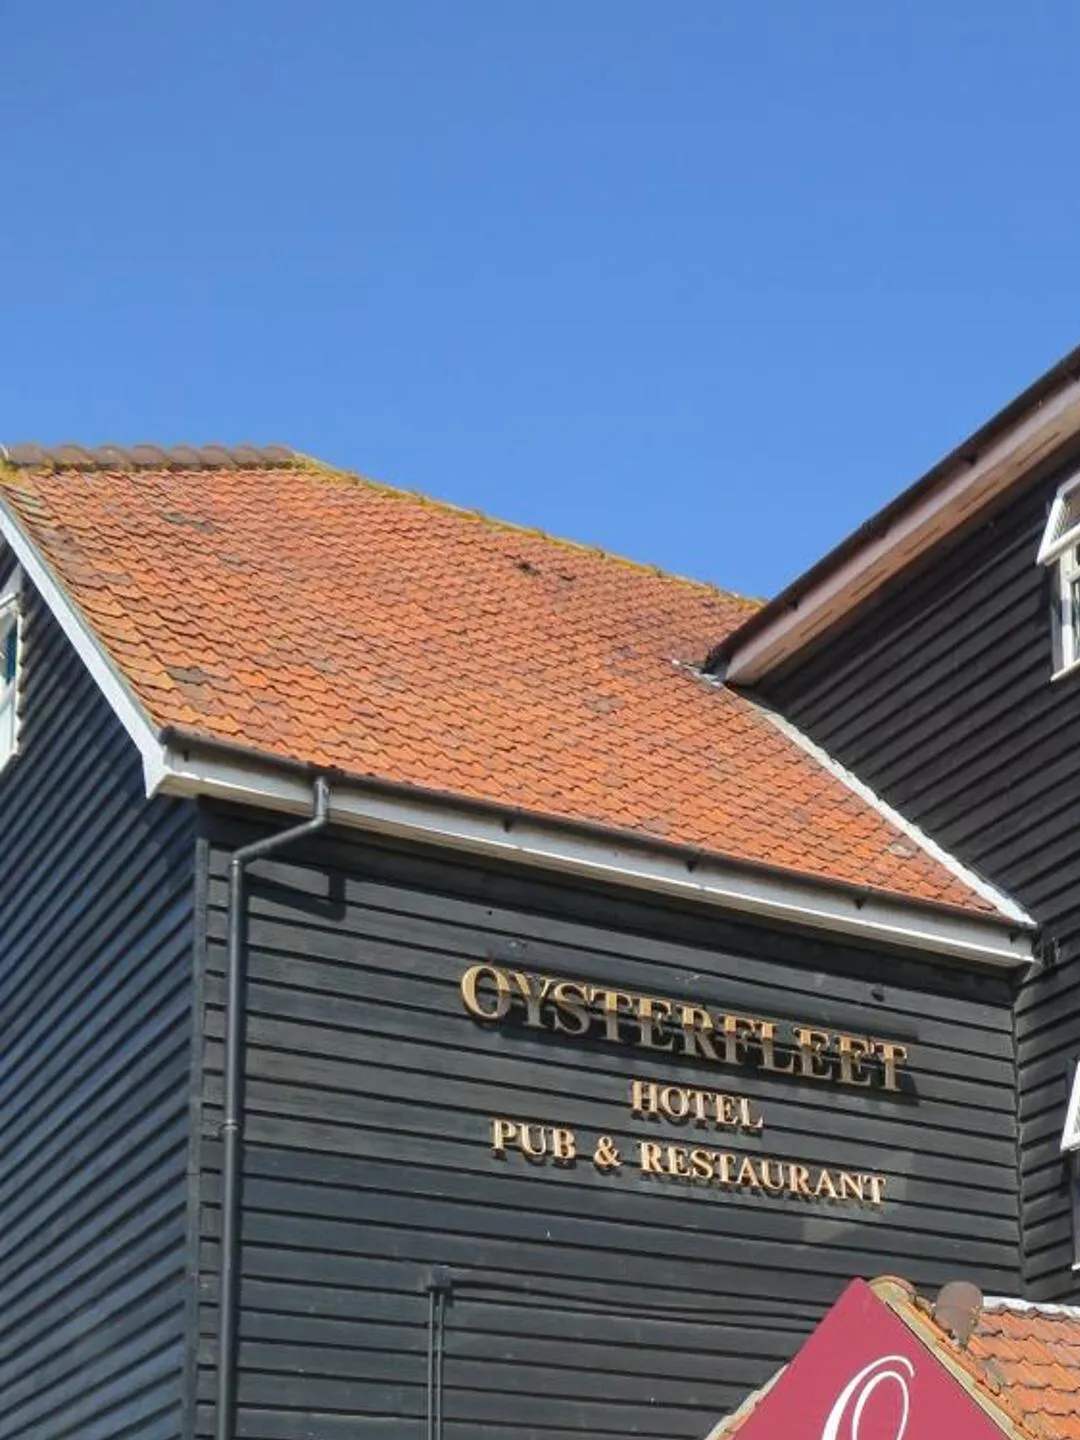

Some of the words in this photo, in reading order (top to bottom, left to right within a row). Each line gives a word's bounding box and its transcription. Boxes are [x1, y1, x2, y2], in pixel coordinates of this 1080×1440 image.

[459, 963, 909, 1092] OYSTERFLEET
[630, 1080, 764, 1129] HOTEL
[489, 1118, 577, 1161] PUB
[593, 1135, 622, 1168] &
[636, 1141, 887, 1206] RESTAURANT
